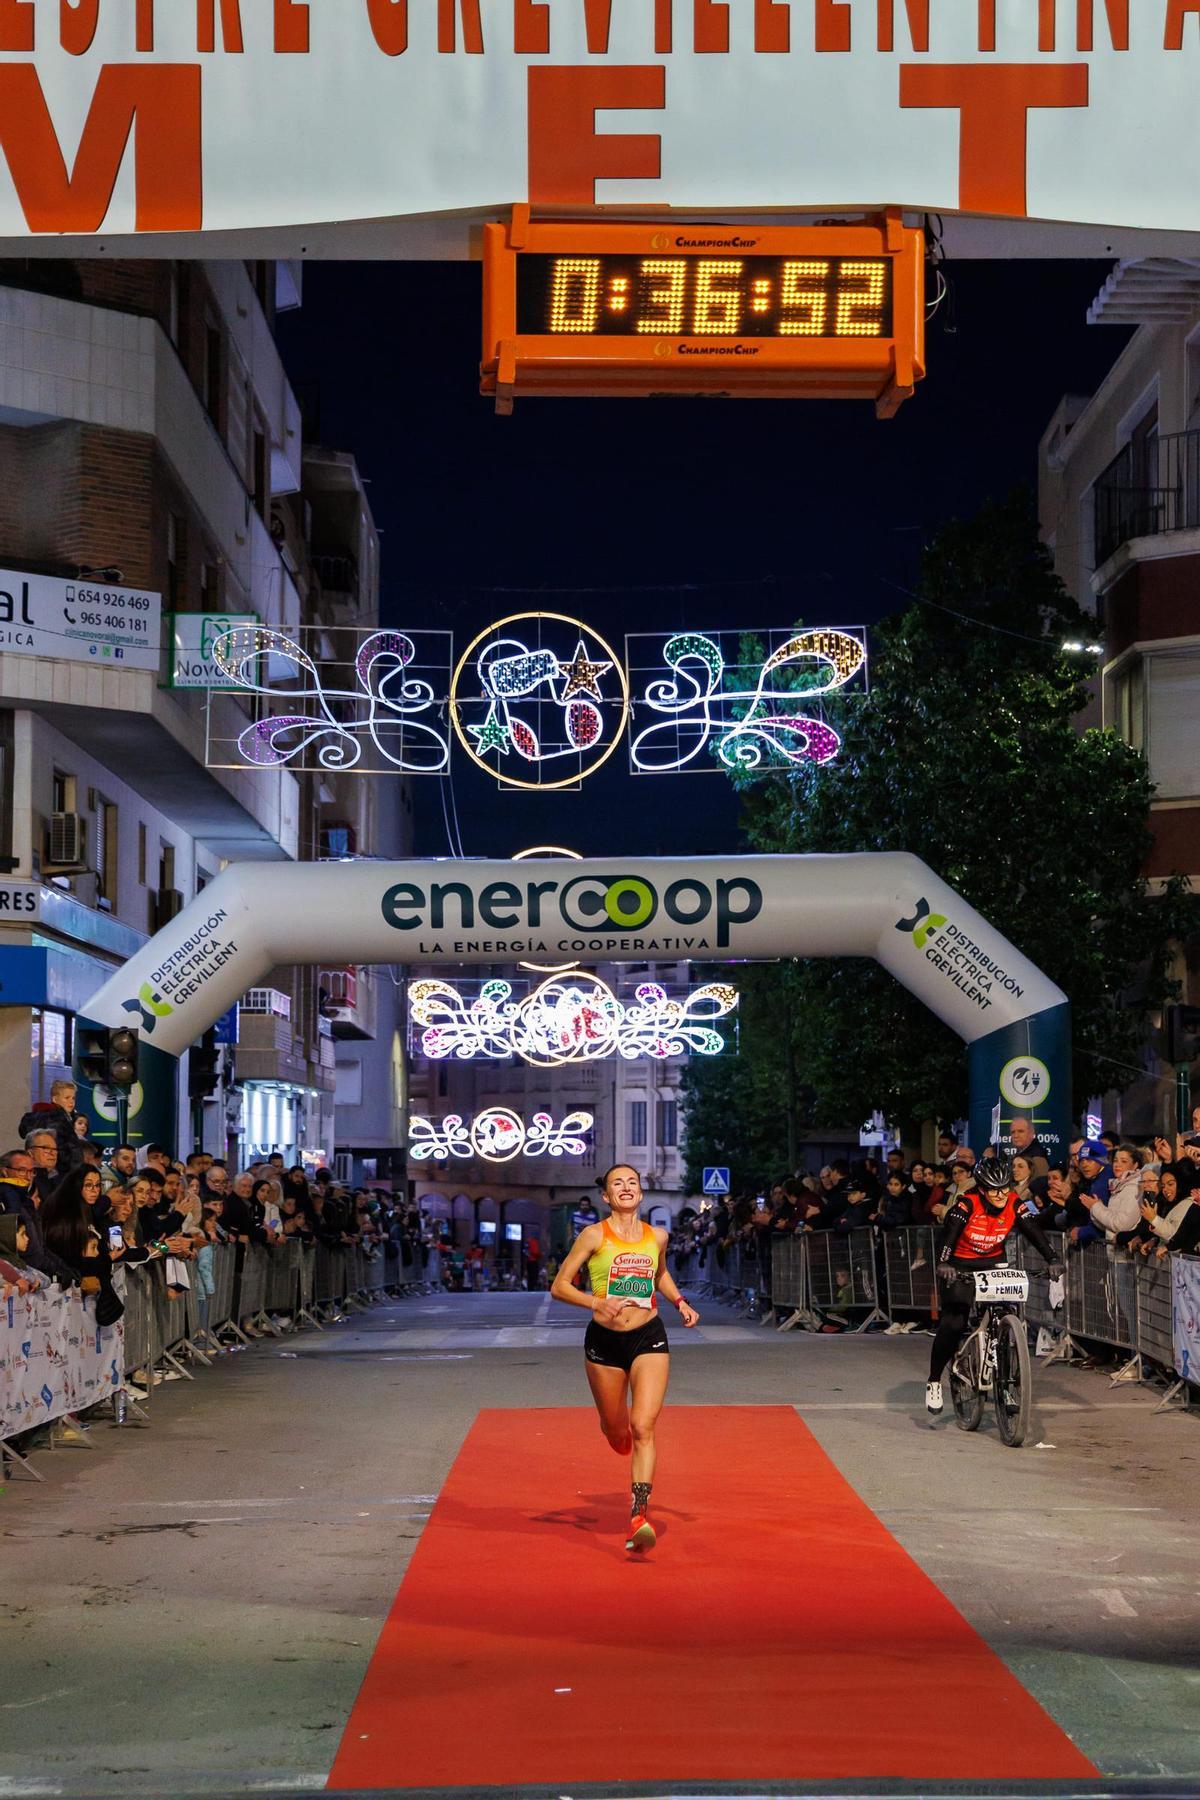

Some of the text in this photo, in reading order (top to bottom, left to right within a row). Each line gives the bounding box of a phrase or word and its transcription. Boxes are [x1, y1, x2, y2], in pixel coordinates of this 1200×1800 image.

[551, 259, 885, 336] 0:36:52
[78, 589, 150, 611] 654 926 469
[0, 630, 34, 646] ICA
[80, 612, 148, 632] 965 406 181
[0, 890, 36, 912] RES
[381, 875, 763, 948] enercoop
[150, 908, 228, 984] DISTRIBUCIÓN
[419, 937, 710, 953] LA ENERGÍA COOPERATIVA
[934, 935, 993, 993] ELÉCTRICA
[946, 924, 1024, 999] DISTRIBUCIÓN
[161, 939, 222, 995] ELÉCTRICA
[174, 941, 238, 1005] CREVILLENT
[925, 948, 992, 1010] CREVILLENT
[616, 1256, 651, 1265] Serrano
[991, 1271, 1026, 1279] GENERAL
[615, 1280, 648, 1294] 2004
